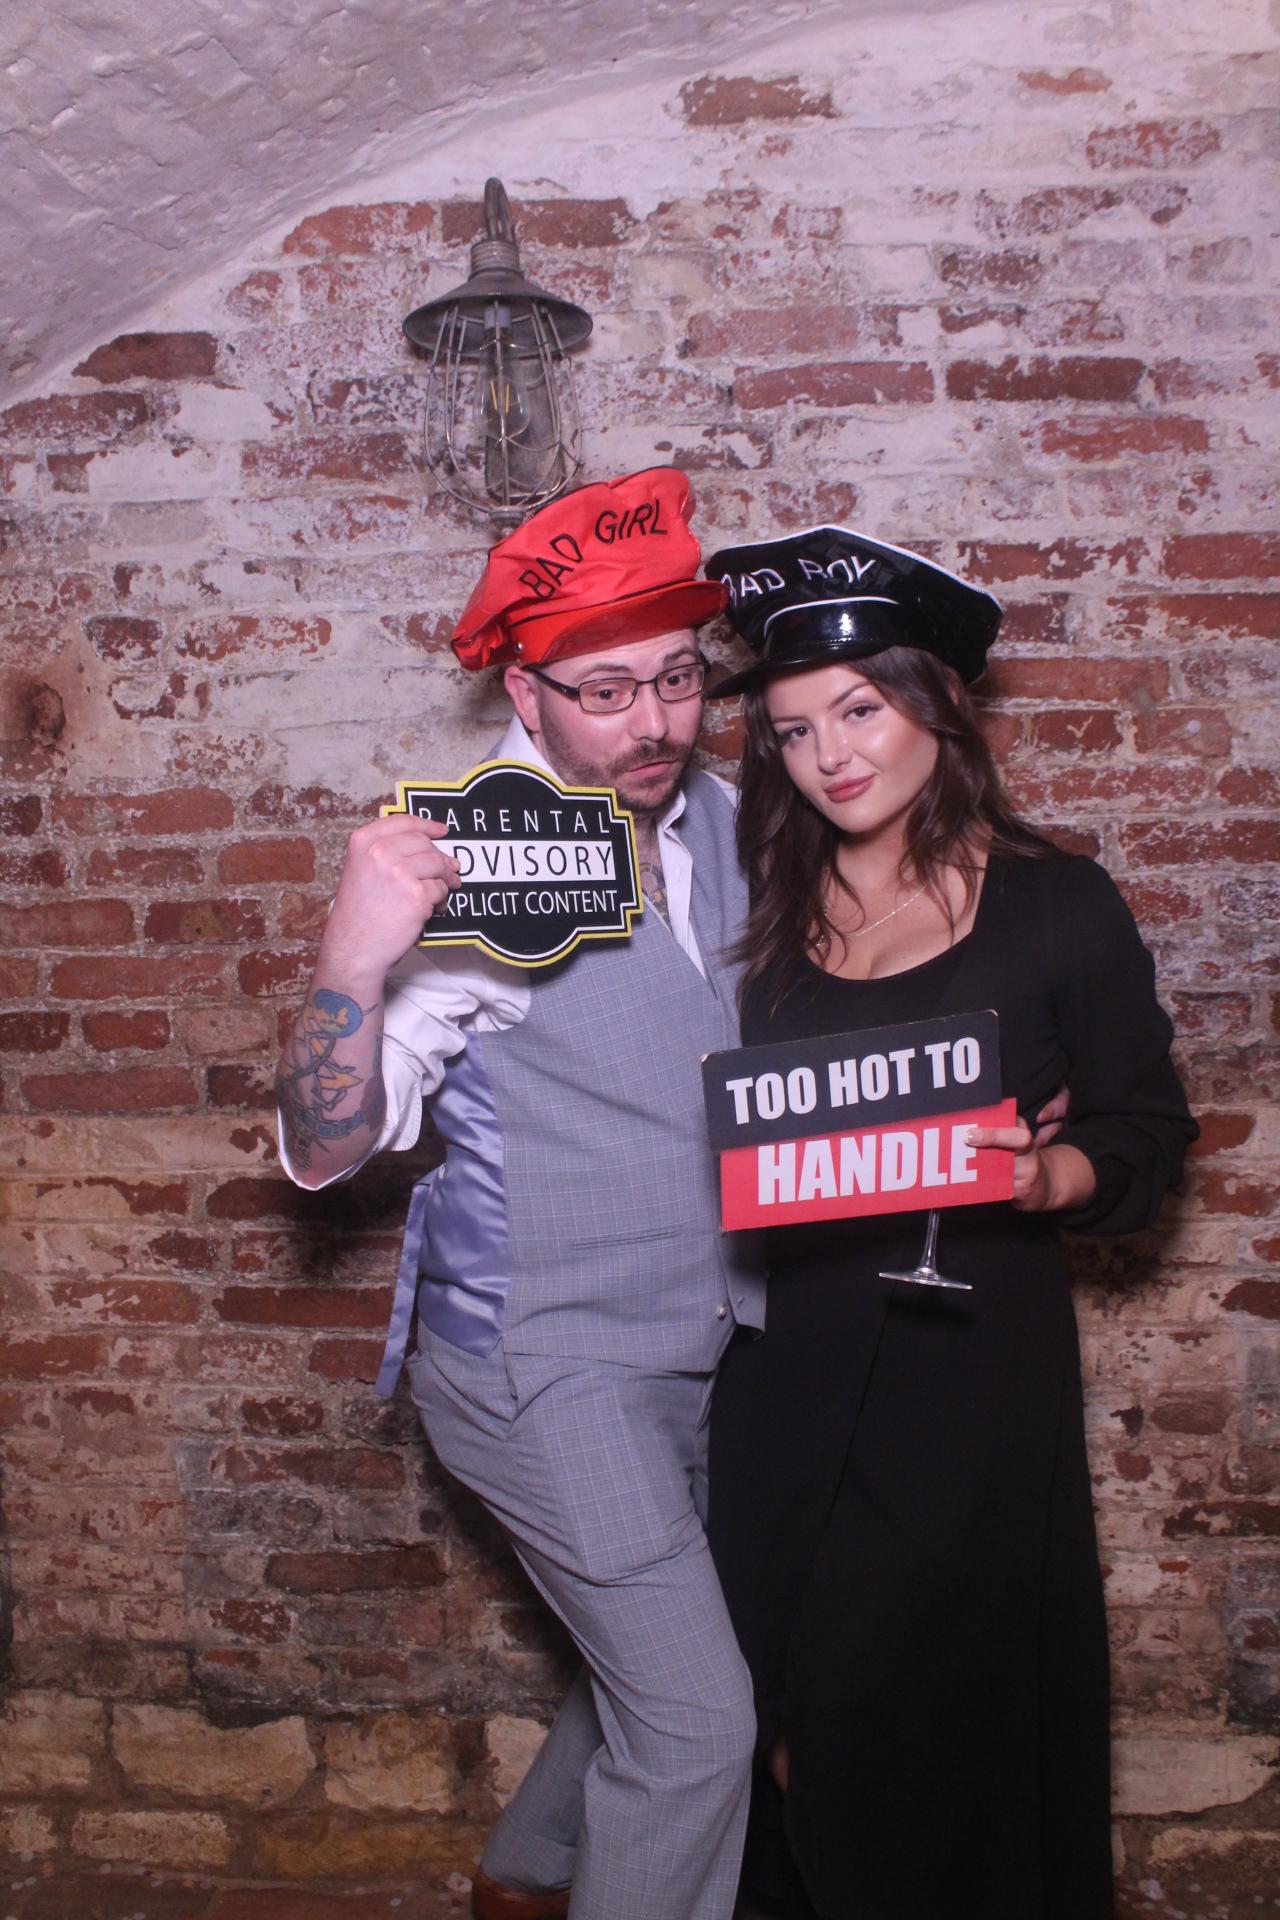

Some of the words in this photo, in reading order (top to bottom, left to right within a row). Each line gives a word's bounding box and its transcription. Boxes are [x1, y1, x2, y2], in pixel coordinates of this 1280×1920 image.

[518, 533, 584, 600] BAD
[594, 498, 668, 545] GIRL
[452, 844, 613, 877] DVISORY
[434, 891, 520, 918] XPLICIT
[525, 889, 618, 916] CONTENT
[725, 1066, 818, 1126] TOO
[827, 1047, 916, 1109] HOT
[924, 1036, 982, 1089] TO
[757, 1122, 980, 1206] HANDLE
